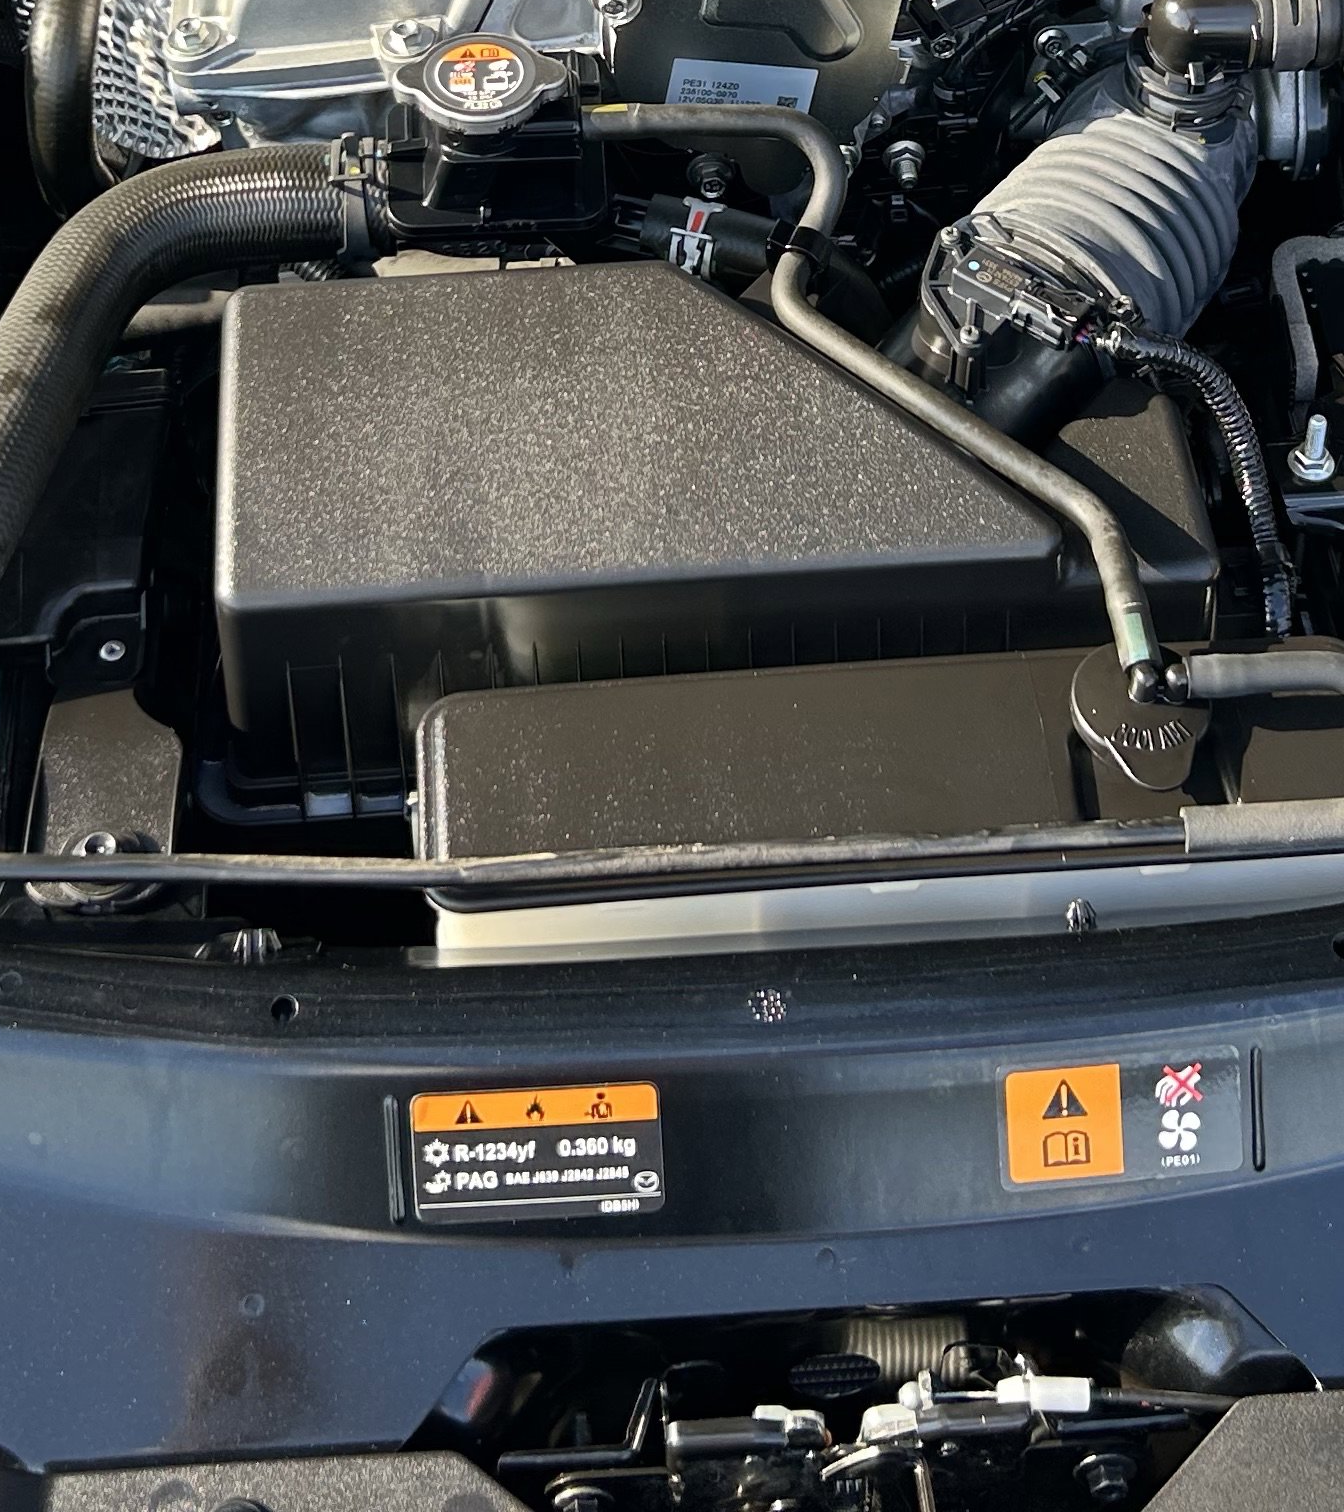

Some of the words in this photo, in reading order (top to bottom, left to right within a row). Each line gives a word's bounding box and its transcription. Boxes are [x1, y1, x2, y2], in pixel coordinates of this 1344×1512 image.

[682, 78, 707, 88] PE31
[1111, 719, 1193, 751] COOLANT
[452, 1140, 536, 1164] R-1234yf
[557, 1136, 608, 1158] 0.360
[612, 1135, 637, 1158] kg
[1160, 1152, 1201, 1168] (PE01)
[456, 1169, 499, 1191] PAG
[505, 1171, 530, 1185] SAE
